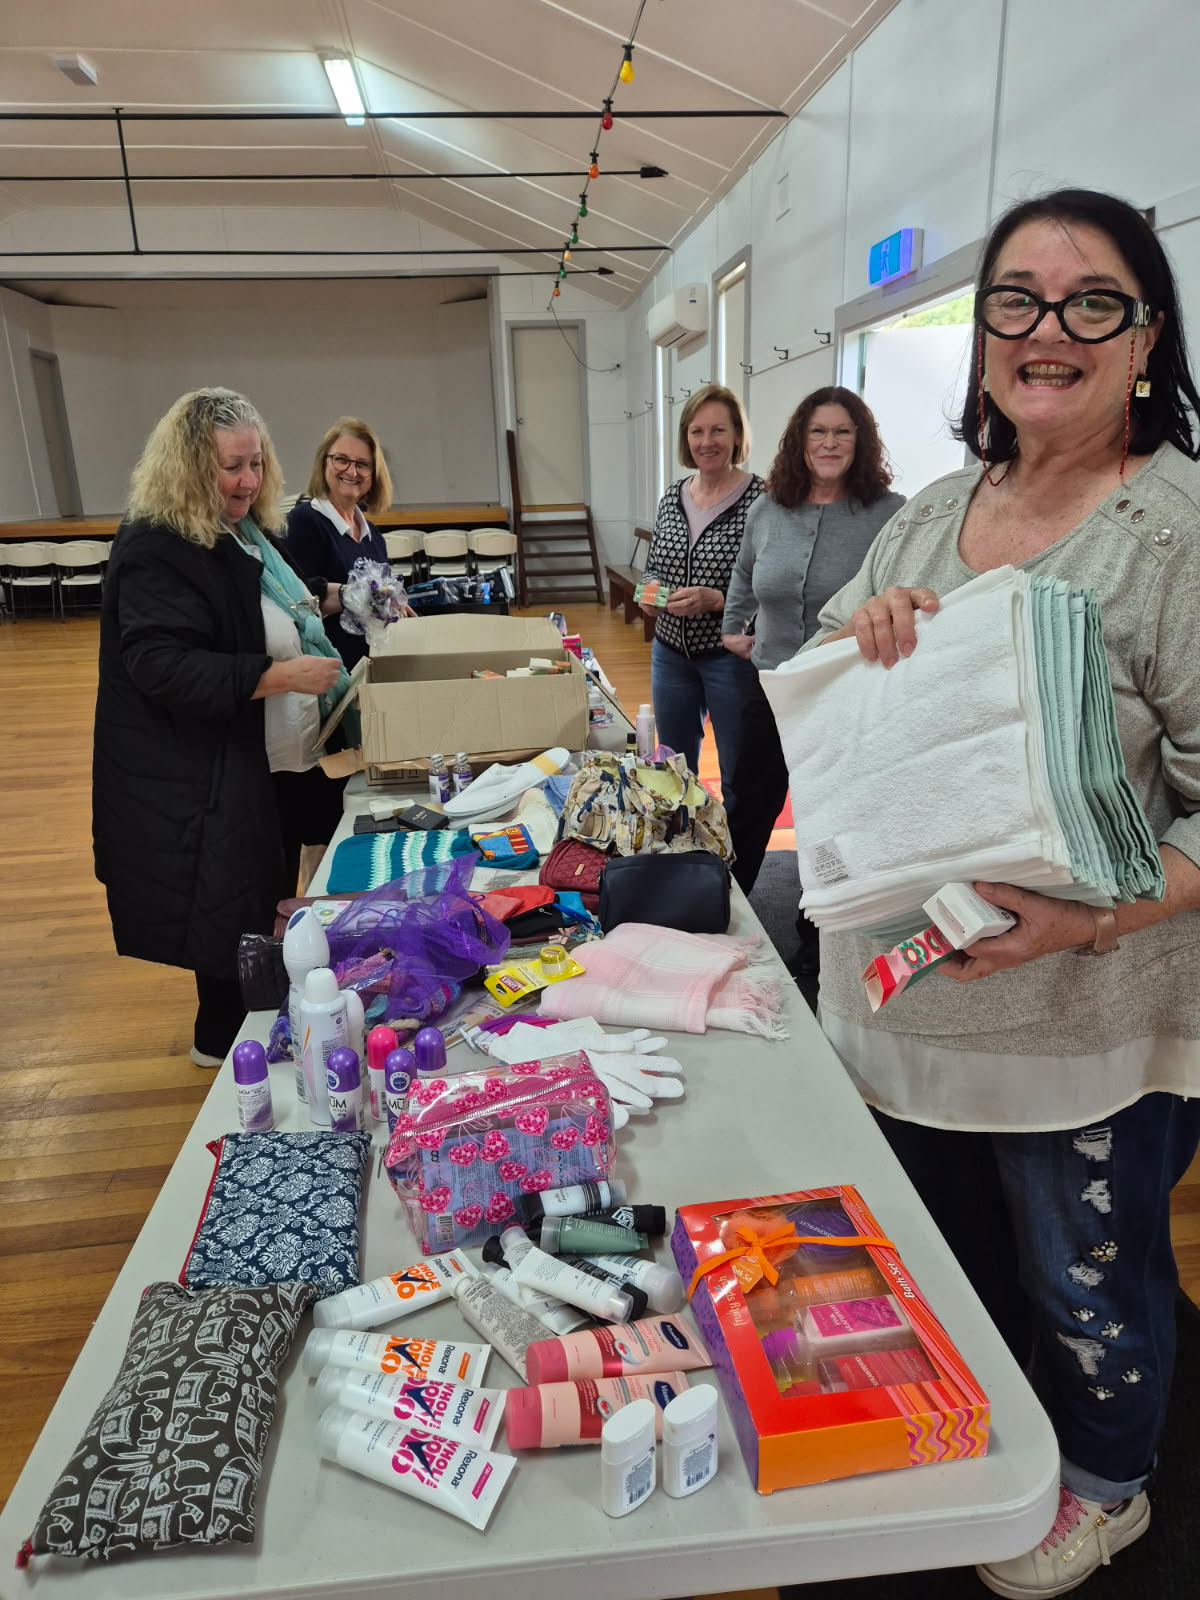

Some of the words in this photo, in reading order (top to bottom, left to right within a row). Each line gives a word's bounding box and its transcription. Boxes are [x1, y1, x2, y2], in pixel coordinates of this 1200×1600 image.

[416, 1262, 442, 1290] WHOLE
[433, 1258, 452, 1278] Rexona
[887, 1262, 901, 1275] Set
[895, 1277, 915, 1298] Bath
[728, 1301, 749, 1327] fruity
[416, 1340, 438, 1380] WHOLE
[439, 1344, 455, 1375] Rexona
[413, 1380, 444, 1427] BODY
[429, 1382, 458, 1430] WHOLE
[452, 1388, 475, 1427] Rexona
[411, 1434, 448, 1484] BODY
[425, 1440, 461, 1489] WHOLE
[451, 1450, 478, 1488] Rexona
